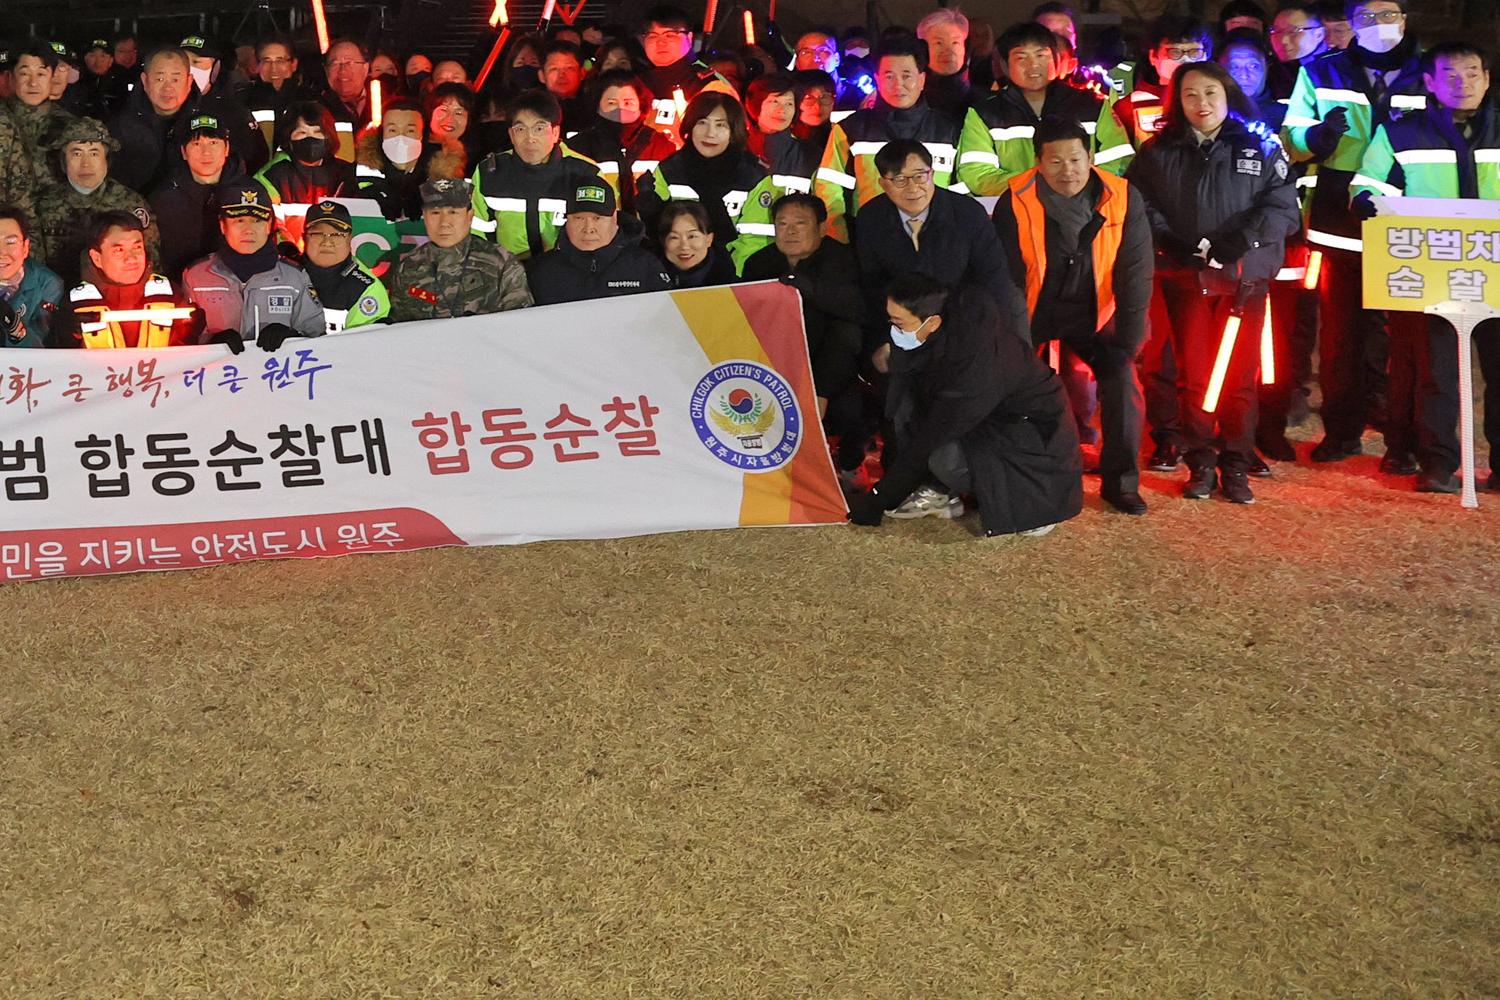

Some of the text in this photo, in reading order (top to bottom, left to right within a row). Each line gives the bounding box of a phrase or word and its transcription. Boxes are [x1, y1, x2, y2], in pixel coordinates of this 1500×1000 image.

[62, 373, 94, 403] 큰
[105, 357, 170, 408] 행복,
[183, 367, 206, 394] 더
[217, 364, 249, 394] 큰
[261, 349, 332, 400] 원주
[692, 365, 793, 418] CHILGOK CITIZEN'S PATROL
[74, 417, 392, 499] 합동순찰대
[411, 394, 661, 476] 합동순찰
[79, 535, 183, 567] 지키는
[190, 526, 327, 563] 안전도시
[337, 521, 404, 551] 원주
